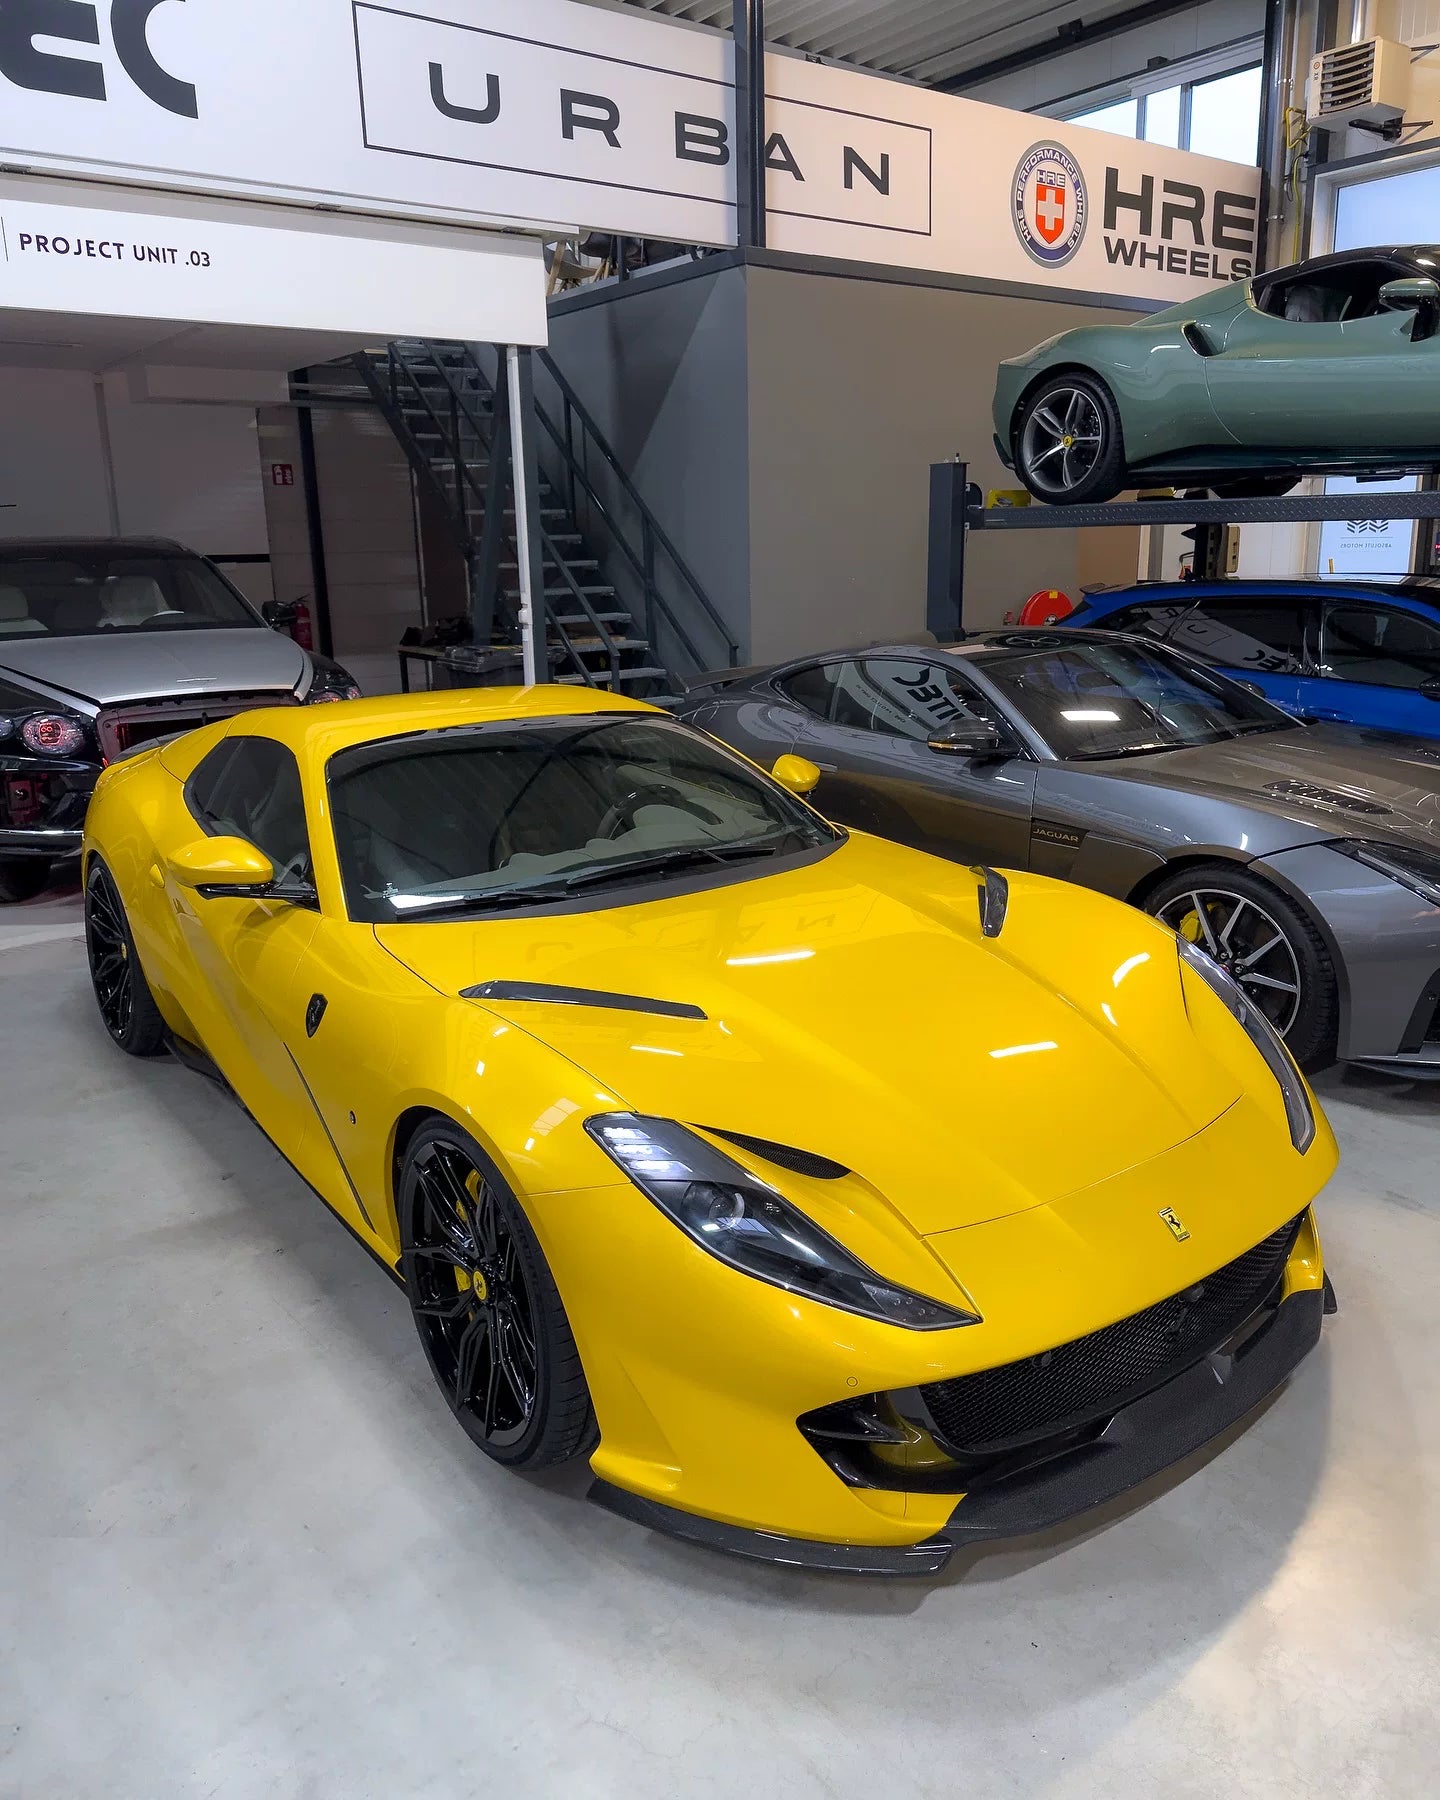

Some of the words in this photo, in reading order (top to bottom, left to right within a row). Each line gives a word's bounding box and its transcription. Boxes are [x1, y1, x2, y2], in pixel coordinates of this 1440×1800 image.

[428, 61, 890, 196] URBAN
[1017, 149, 1080, 202] PERFORMANCE
[1067, 186, 1084, 249] WHEELS
[1036, 168, 1066, 188] HRE
[1103, 166, 1257, 254] HRE
[19, 232, 125, 260] PROJECT
[132, 243, 178, 264] UNIT
[185, 250, 211, 267] .03
[1103, 235, 1252, 282] WHEELS
[1033, 828, 1080, 842] JAGUAR
